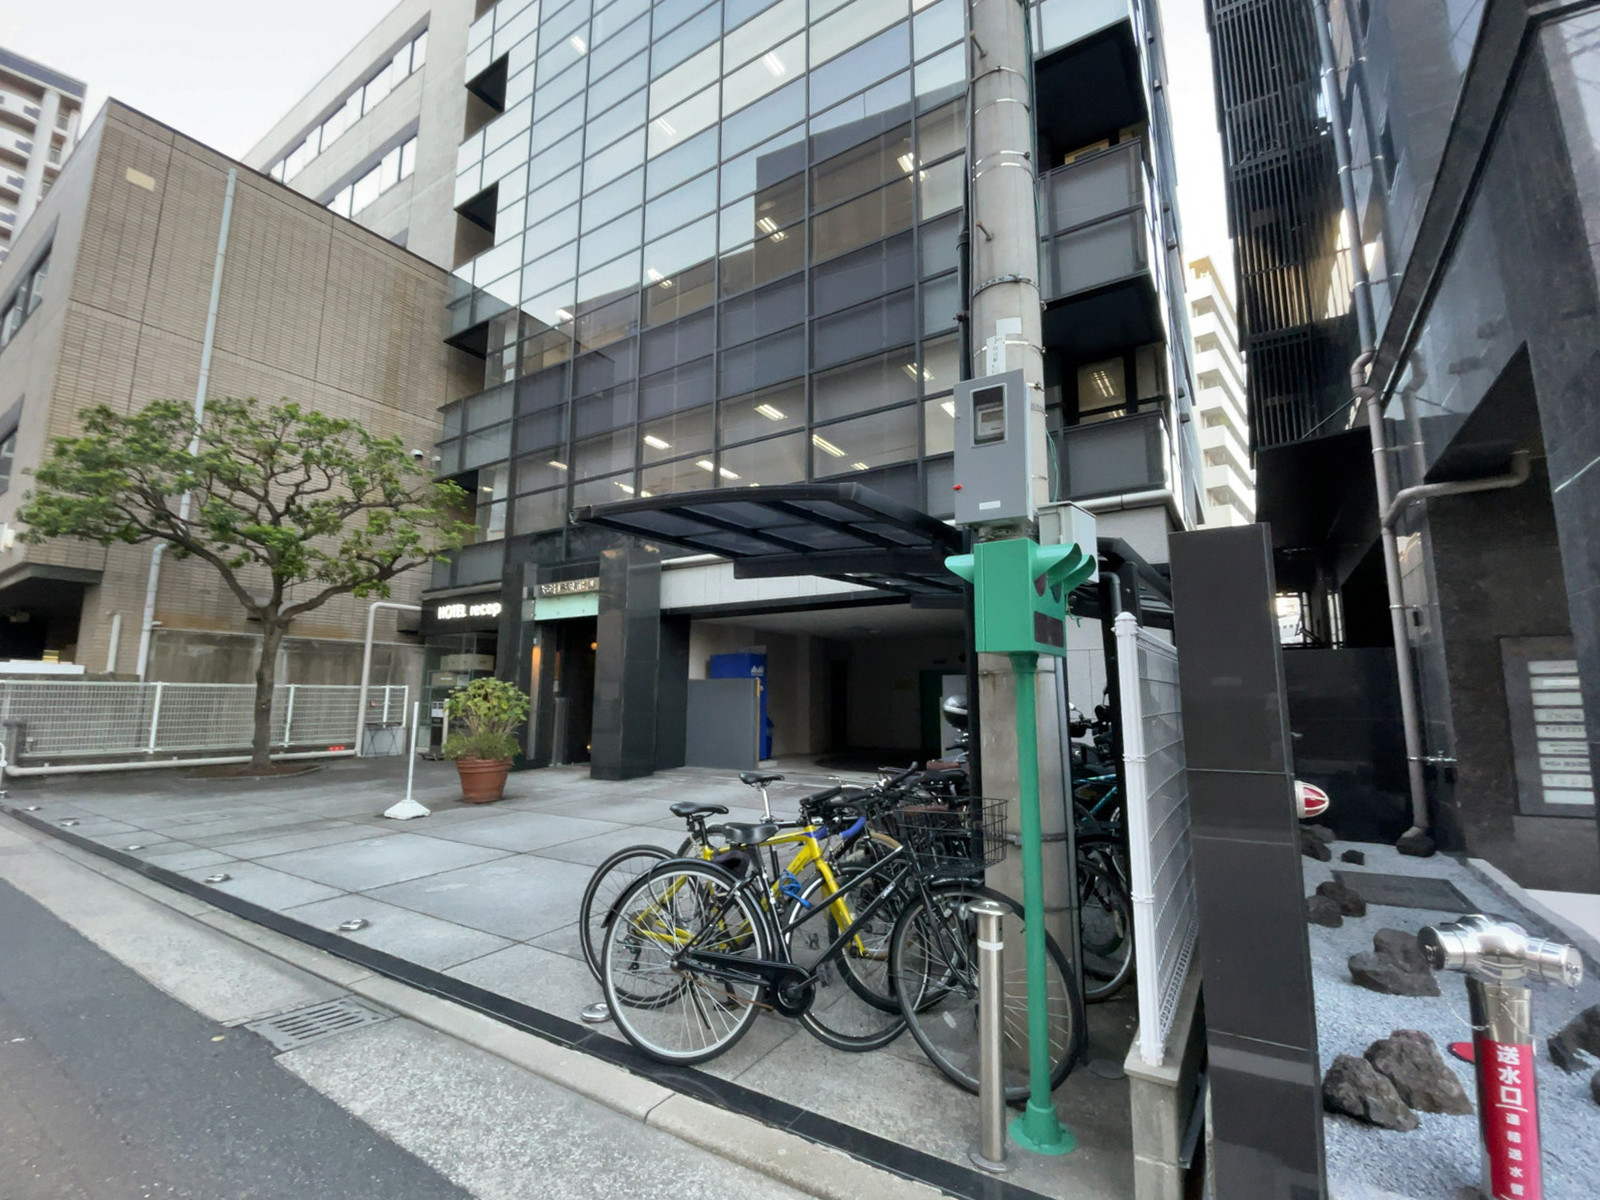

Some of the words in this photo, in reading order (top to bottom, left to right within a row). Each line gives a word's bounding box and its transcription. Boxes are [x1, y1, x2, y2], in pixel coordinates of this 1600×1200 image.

[437, 604, 467, 619] HOTEL
[1496, 1045, 1522, 1106] 送水口
